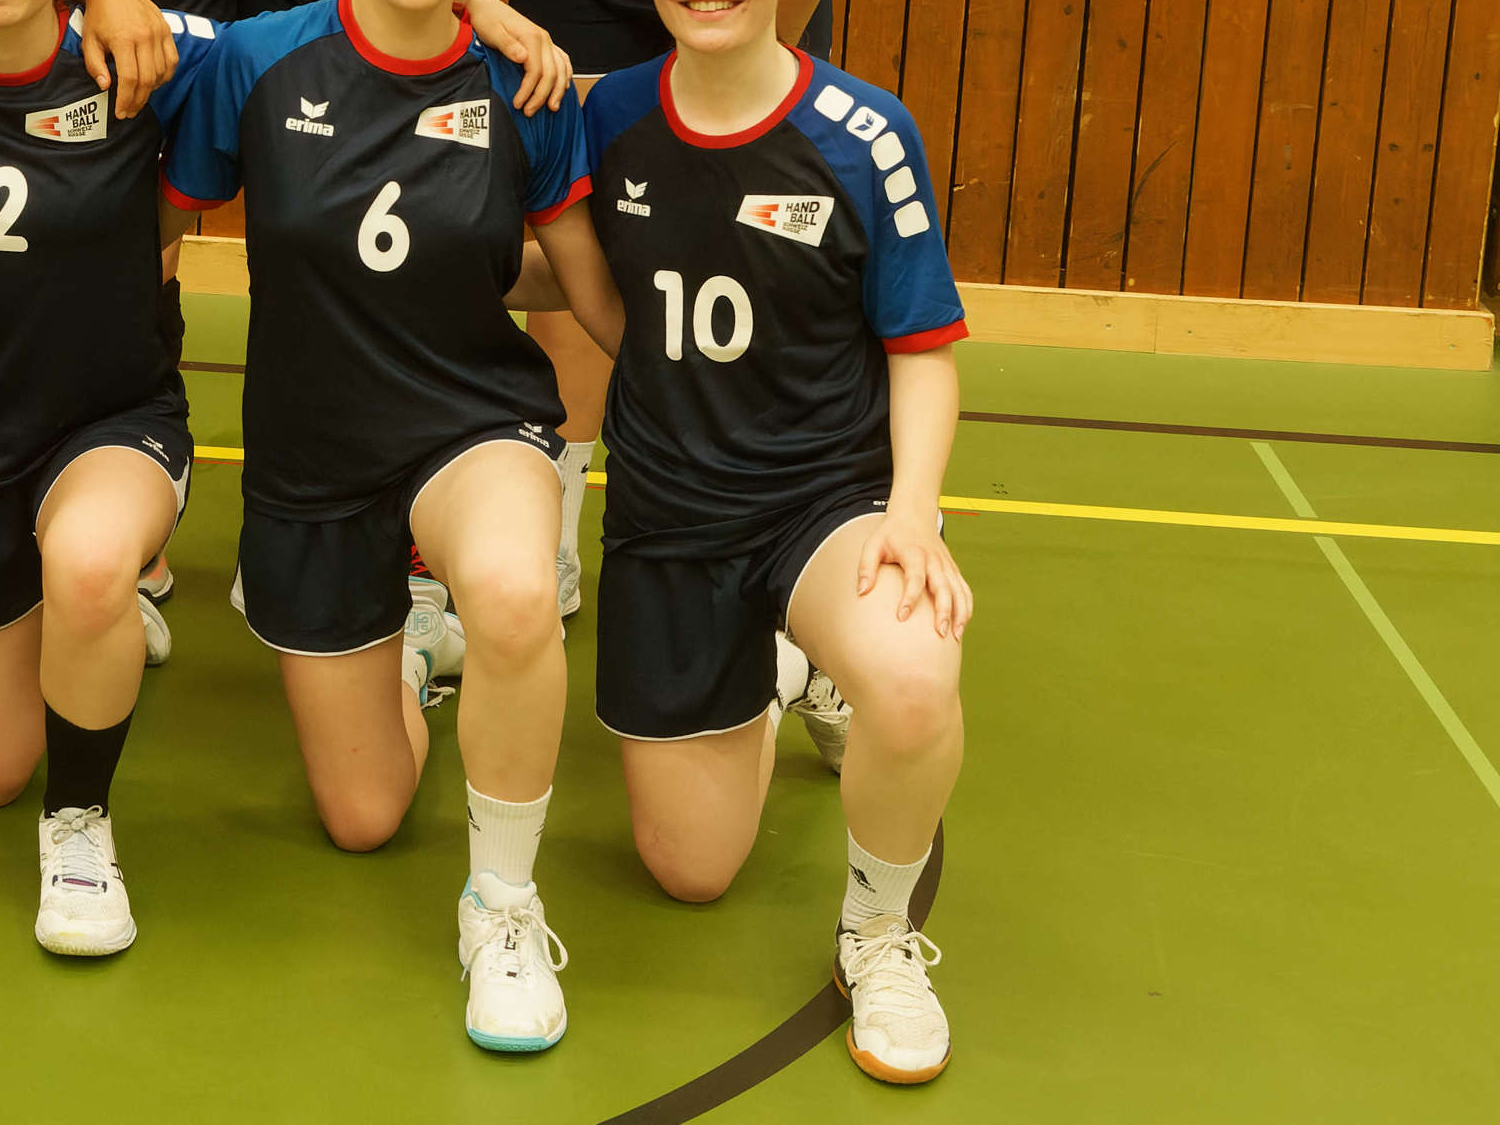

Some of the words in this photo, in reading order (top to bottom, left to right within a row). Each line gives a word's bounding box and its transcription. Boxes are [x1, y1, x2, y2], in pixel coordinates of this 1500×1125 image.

[65, 101, 98, 121] HAND
[460, 105, 487, 118] HAND
[72, 113, 100, 129] BALL
[285, 117, 334, 137] erima
[462, 118, 488, 130] BALL
[616, 199, 651, 217] erima
[785, 201, 820, 213] HAND
[357, 180, 410, 273] 6
[790, 212, 817, 226] BALL
[654, 269, 754, 363] 10
